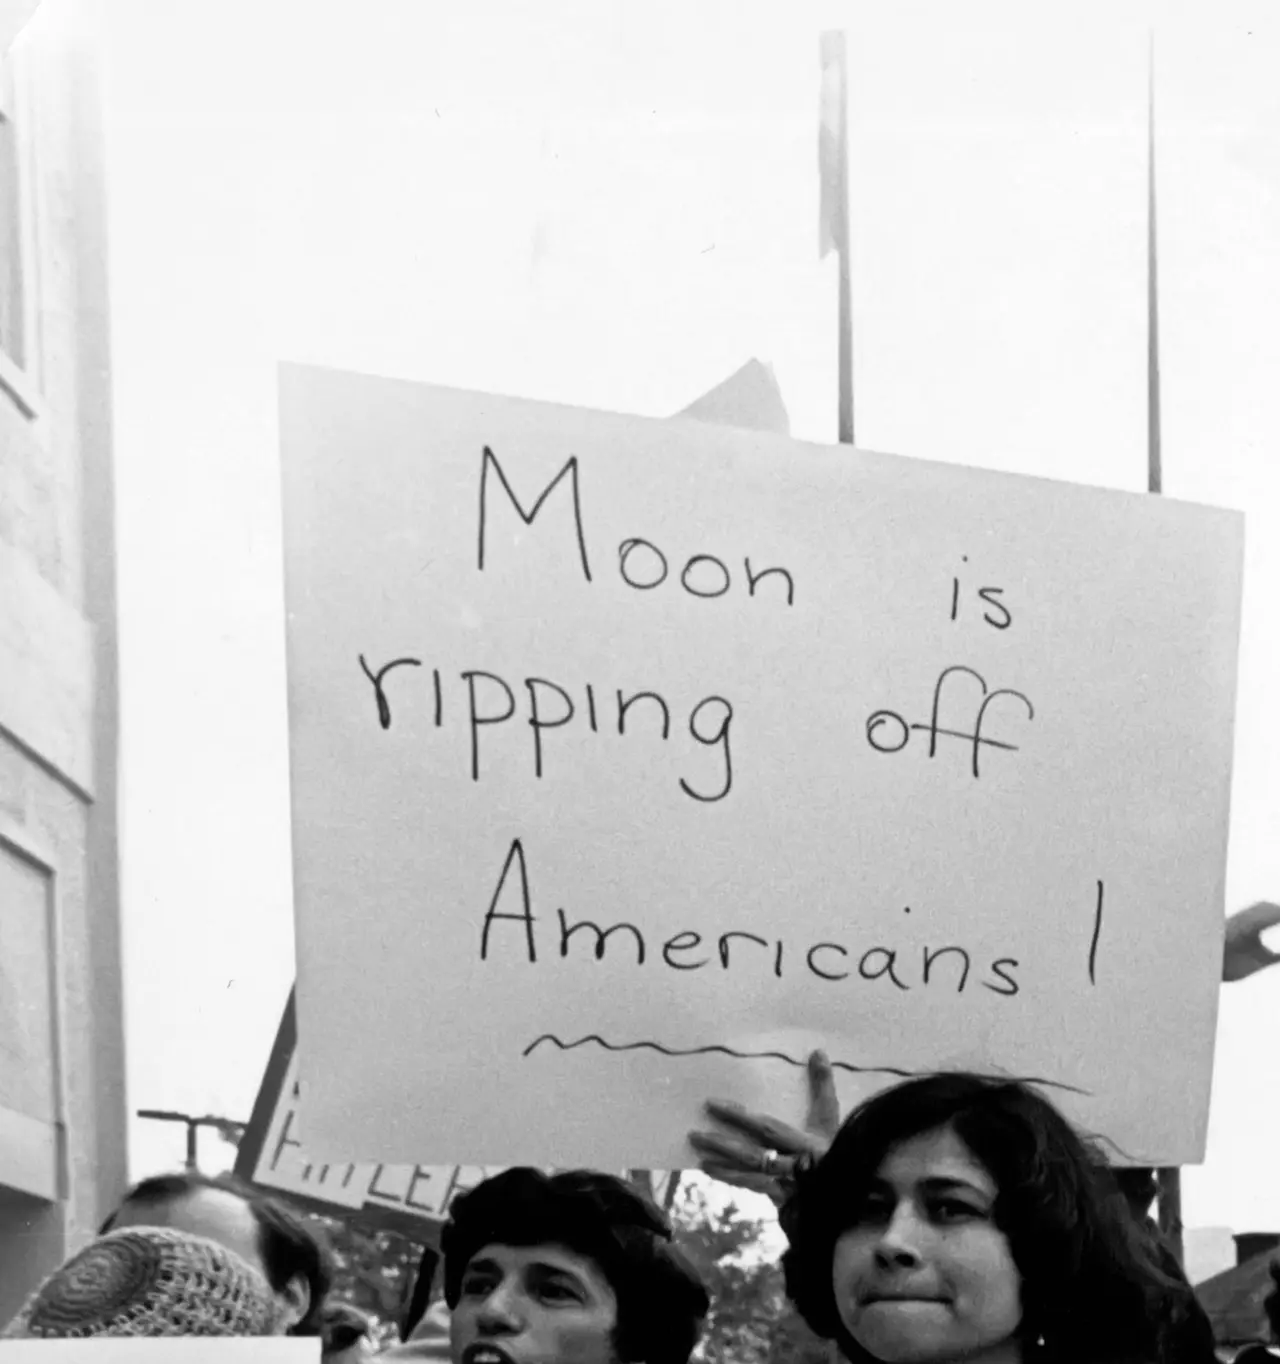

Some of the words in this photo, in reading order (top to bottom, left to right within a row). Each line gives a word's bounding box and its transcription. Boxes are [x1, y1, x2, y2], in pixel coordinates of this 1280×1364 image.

[478, 445, 795, 605] Moon
[951, 555, 1012, 629] is
[359, 653, 733, 802] ripping
[867, 665, 1034, 778] off
